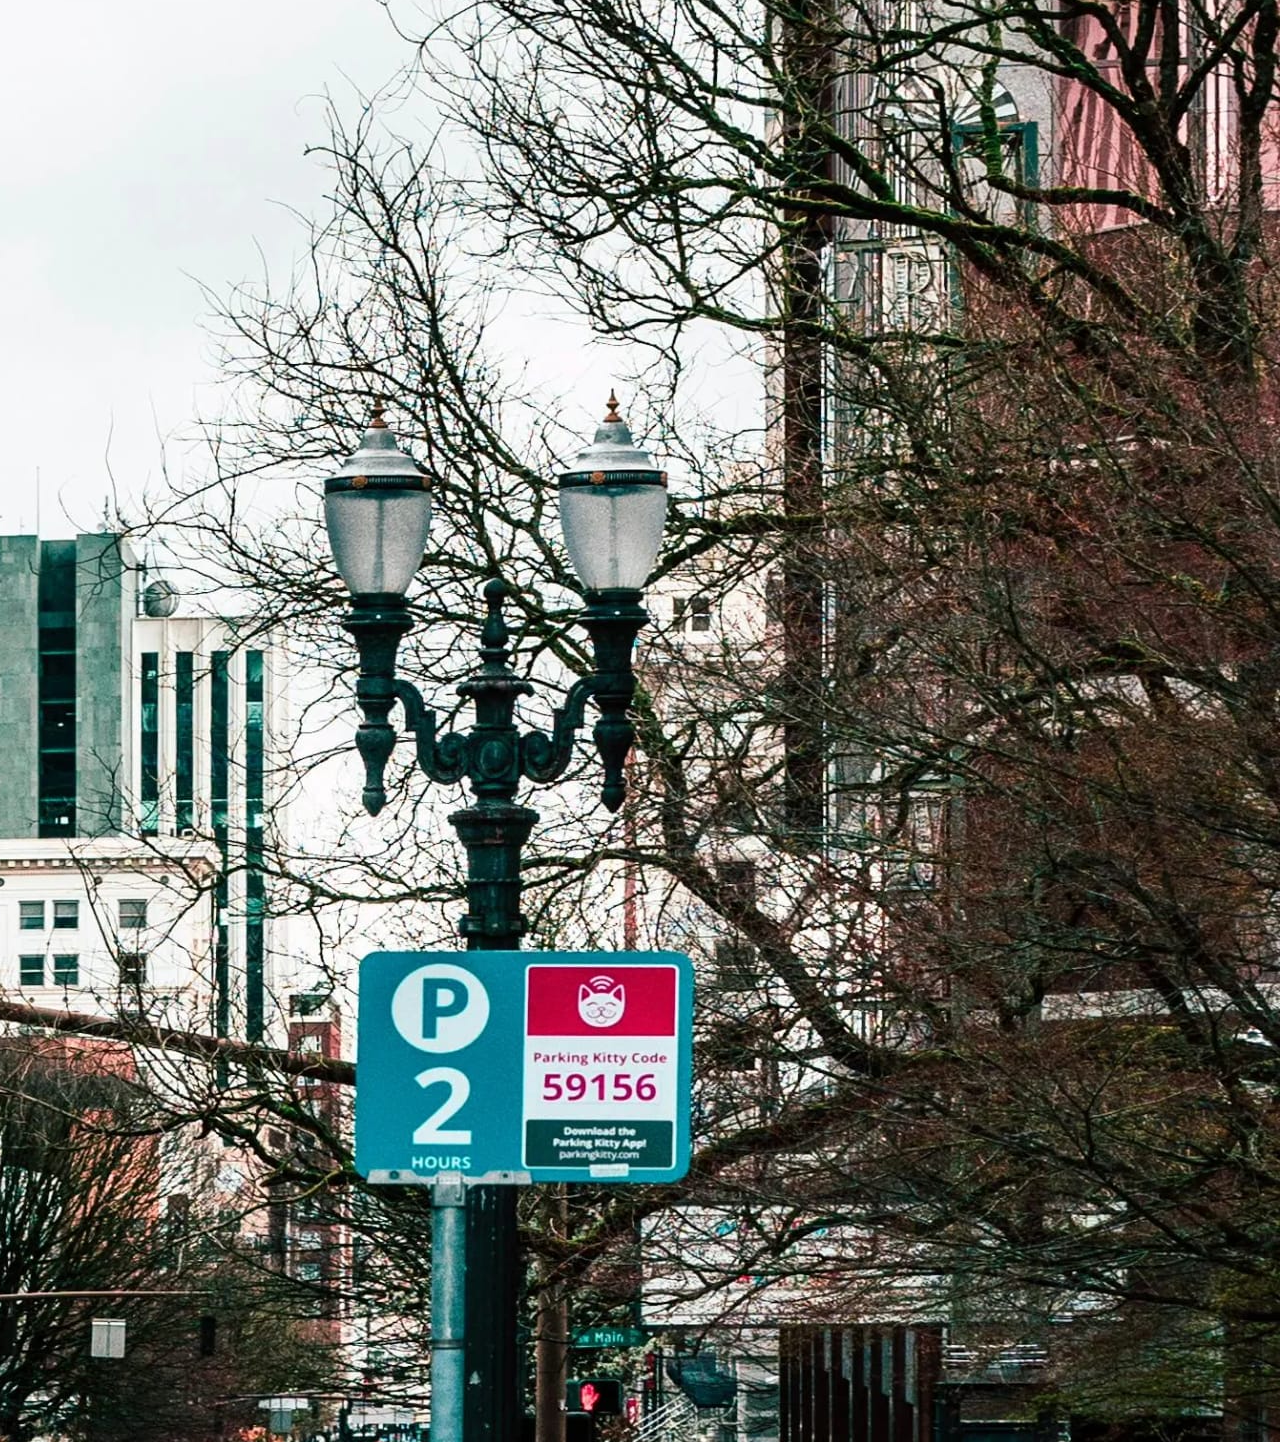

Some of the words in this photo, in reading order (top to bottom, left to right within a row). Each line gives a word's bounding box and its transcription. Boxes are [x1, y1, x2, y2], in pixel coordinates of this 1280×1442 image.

[421, 977, 469, 1040] P
[533, 1052, 589, 1066] Parking
[593, 1052, 627, 1066] Kitty
[632, 1052, 667, 1063] Code
[543, 1073, 657, 1101] 59156
[412, 1066, 473, 1145] 2
[563, 1126, 617, 1136] Download
[618, 1126, 637, 1136] the
[552, 1138, 593, 1149] Parking
[594, 1138, 621, 1149] Kitty
[622, 1139, 648, 1149] App!
[411, 1155, 471, 1170] HOURS
[559, 1150, 640, 1161] parkingkitty.com
[595, 1332, 624, 1343] Main
